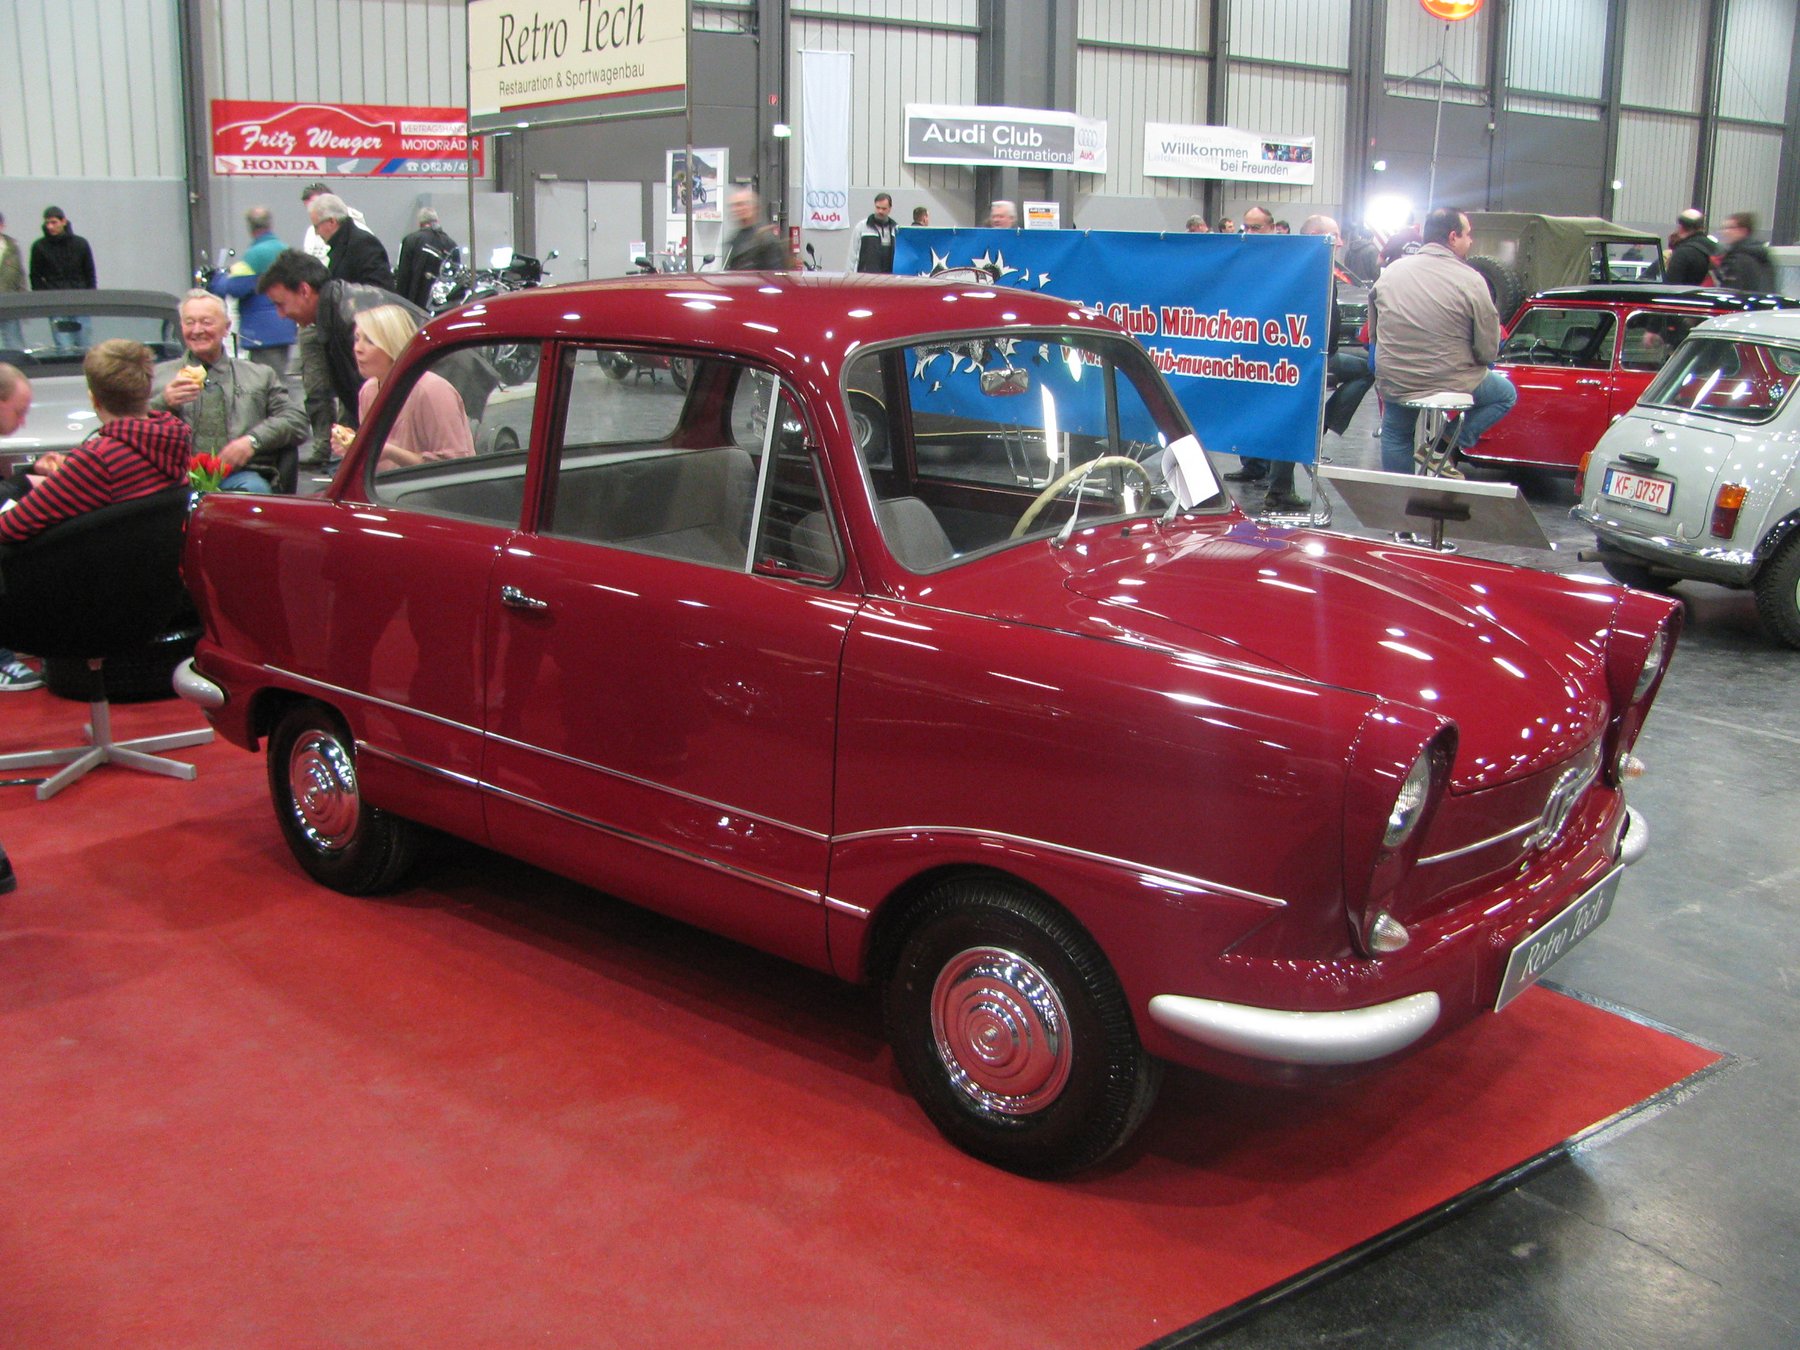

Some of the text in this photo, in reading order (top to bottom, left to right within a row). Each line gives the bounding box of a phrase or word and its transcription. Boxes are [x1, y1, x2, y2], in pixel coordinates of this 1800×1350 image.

[497, 0, 646, 68] Retro Tech
[499, 62, 645, 96] Restauration & Sportwagenbau
[240, 125, 383, 156] Fritz Wenger
[401, 137, 479, 151] MOTORRÄDR
[922, 122, 1043, 147] Audi Club
[993, 146, 1074, 164] International
[1079, 150, 1095, 161] Audi
[1161, 141, 1249, 159] Willkommen
[241, 160, 319, 171] HONDA
[1220, 159, 1289, 176] bei Freunden
[811, 211, 841, 222] Audi
[1106, 303, 1157, 335] Club
[1161, 306, 1258, 345] München
[1263, 314, 1311, 348] e.V.
[1614, 475, 1665, 504] KF 0737
[1519, 889, 1604, 983] Retro Tech
